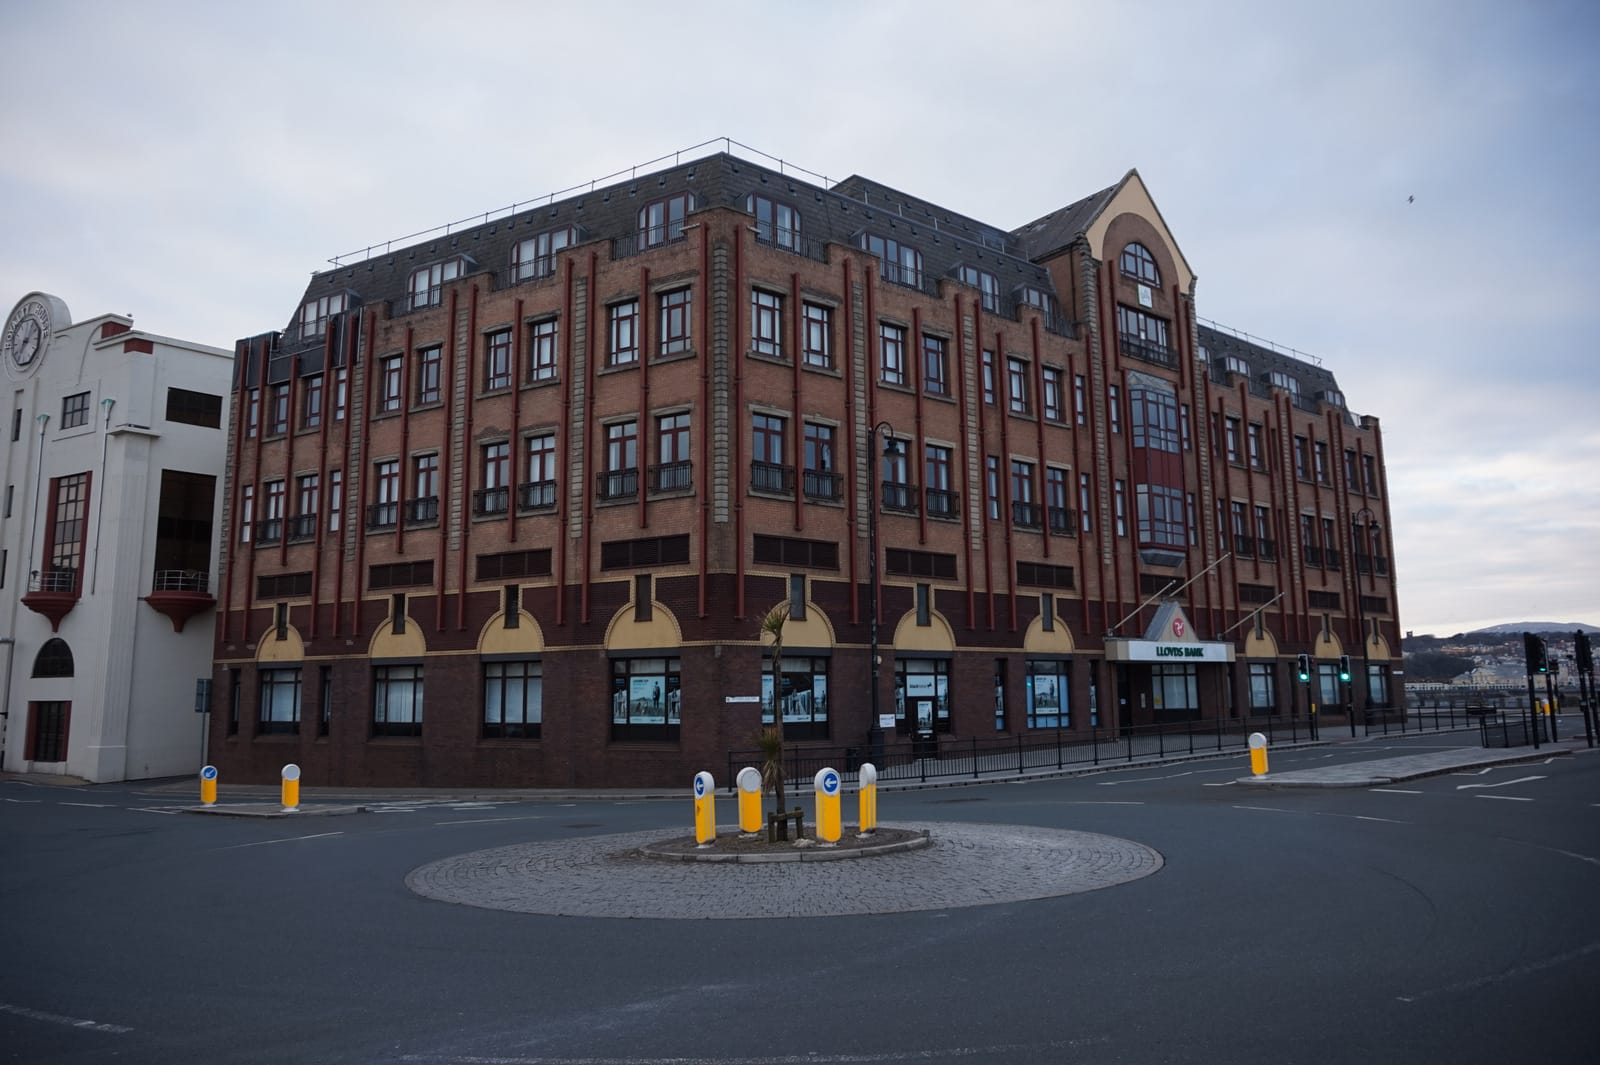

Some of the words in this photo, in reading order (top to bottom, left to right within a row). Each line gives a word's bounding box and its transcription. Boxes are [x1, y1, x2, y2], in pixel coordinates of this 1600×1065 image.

[4, 303, 31, 350] ROYALTY
[34, 303, 49, 339] HOUSE
[1156, 646, 1183, 657] LLOYDS
[1184, 647, 1204, 657] BANK
